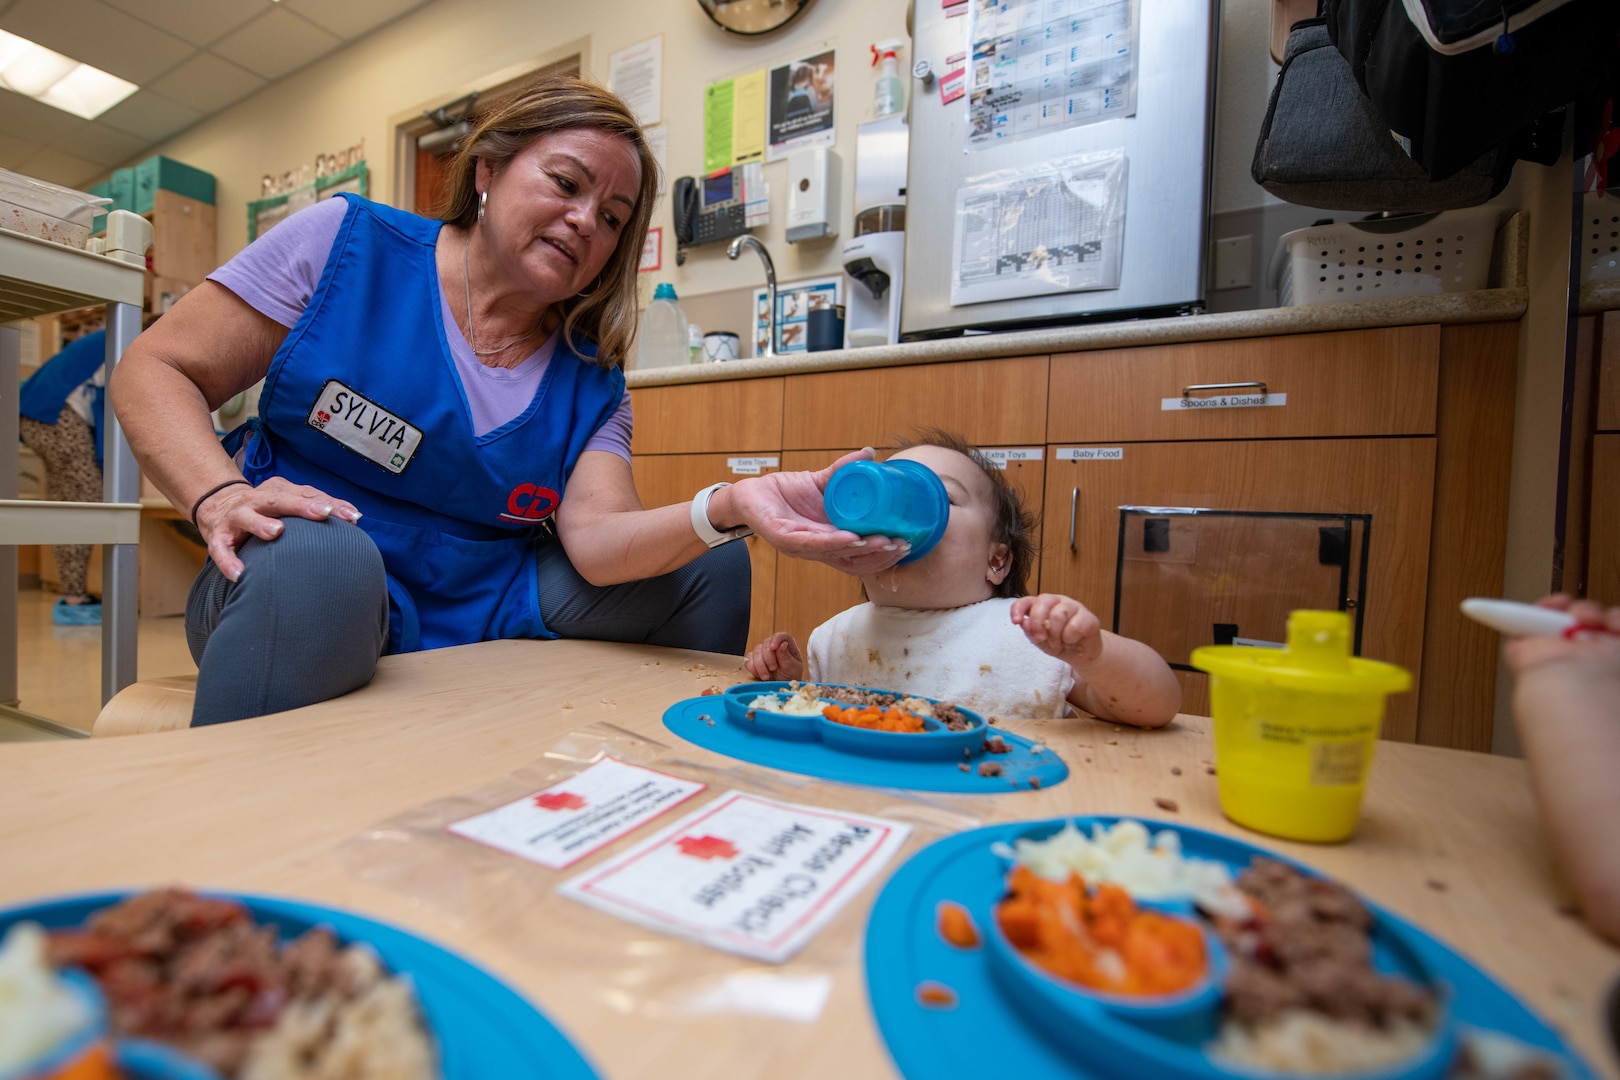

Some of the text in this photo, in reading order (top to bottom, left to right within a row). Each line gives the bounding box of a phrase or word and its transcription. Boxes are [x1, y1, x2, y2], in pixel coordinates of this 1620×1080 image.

[1180, 396, 1266, 408] Spoons & Dishes
[311, 419, 325, 430] CPR
[329, 391, 408, 450] SYLVIA
[985, 451, 1027, 460] Extra Toys
[1073, 449, 1120, 459] Baby Food
